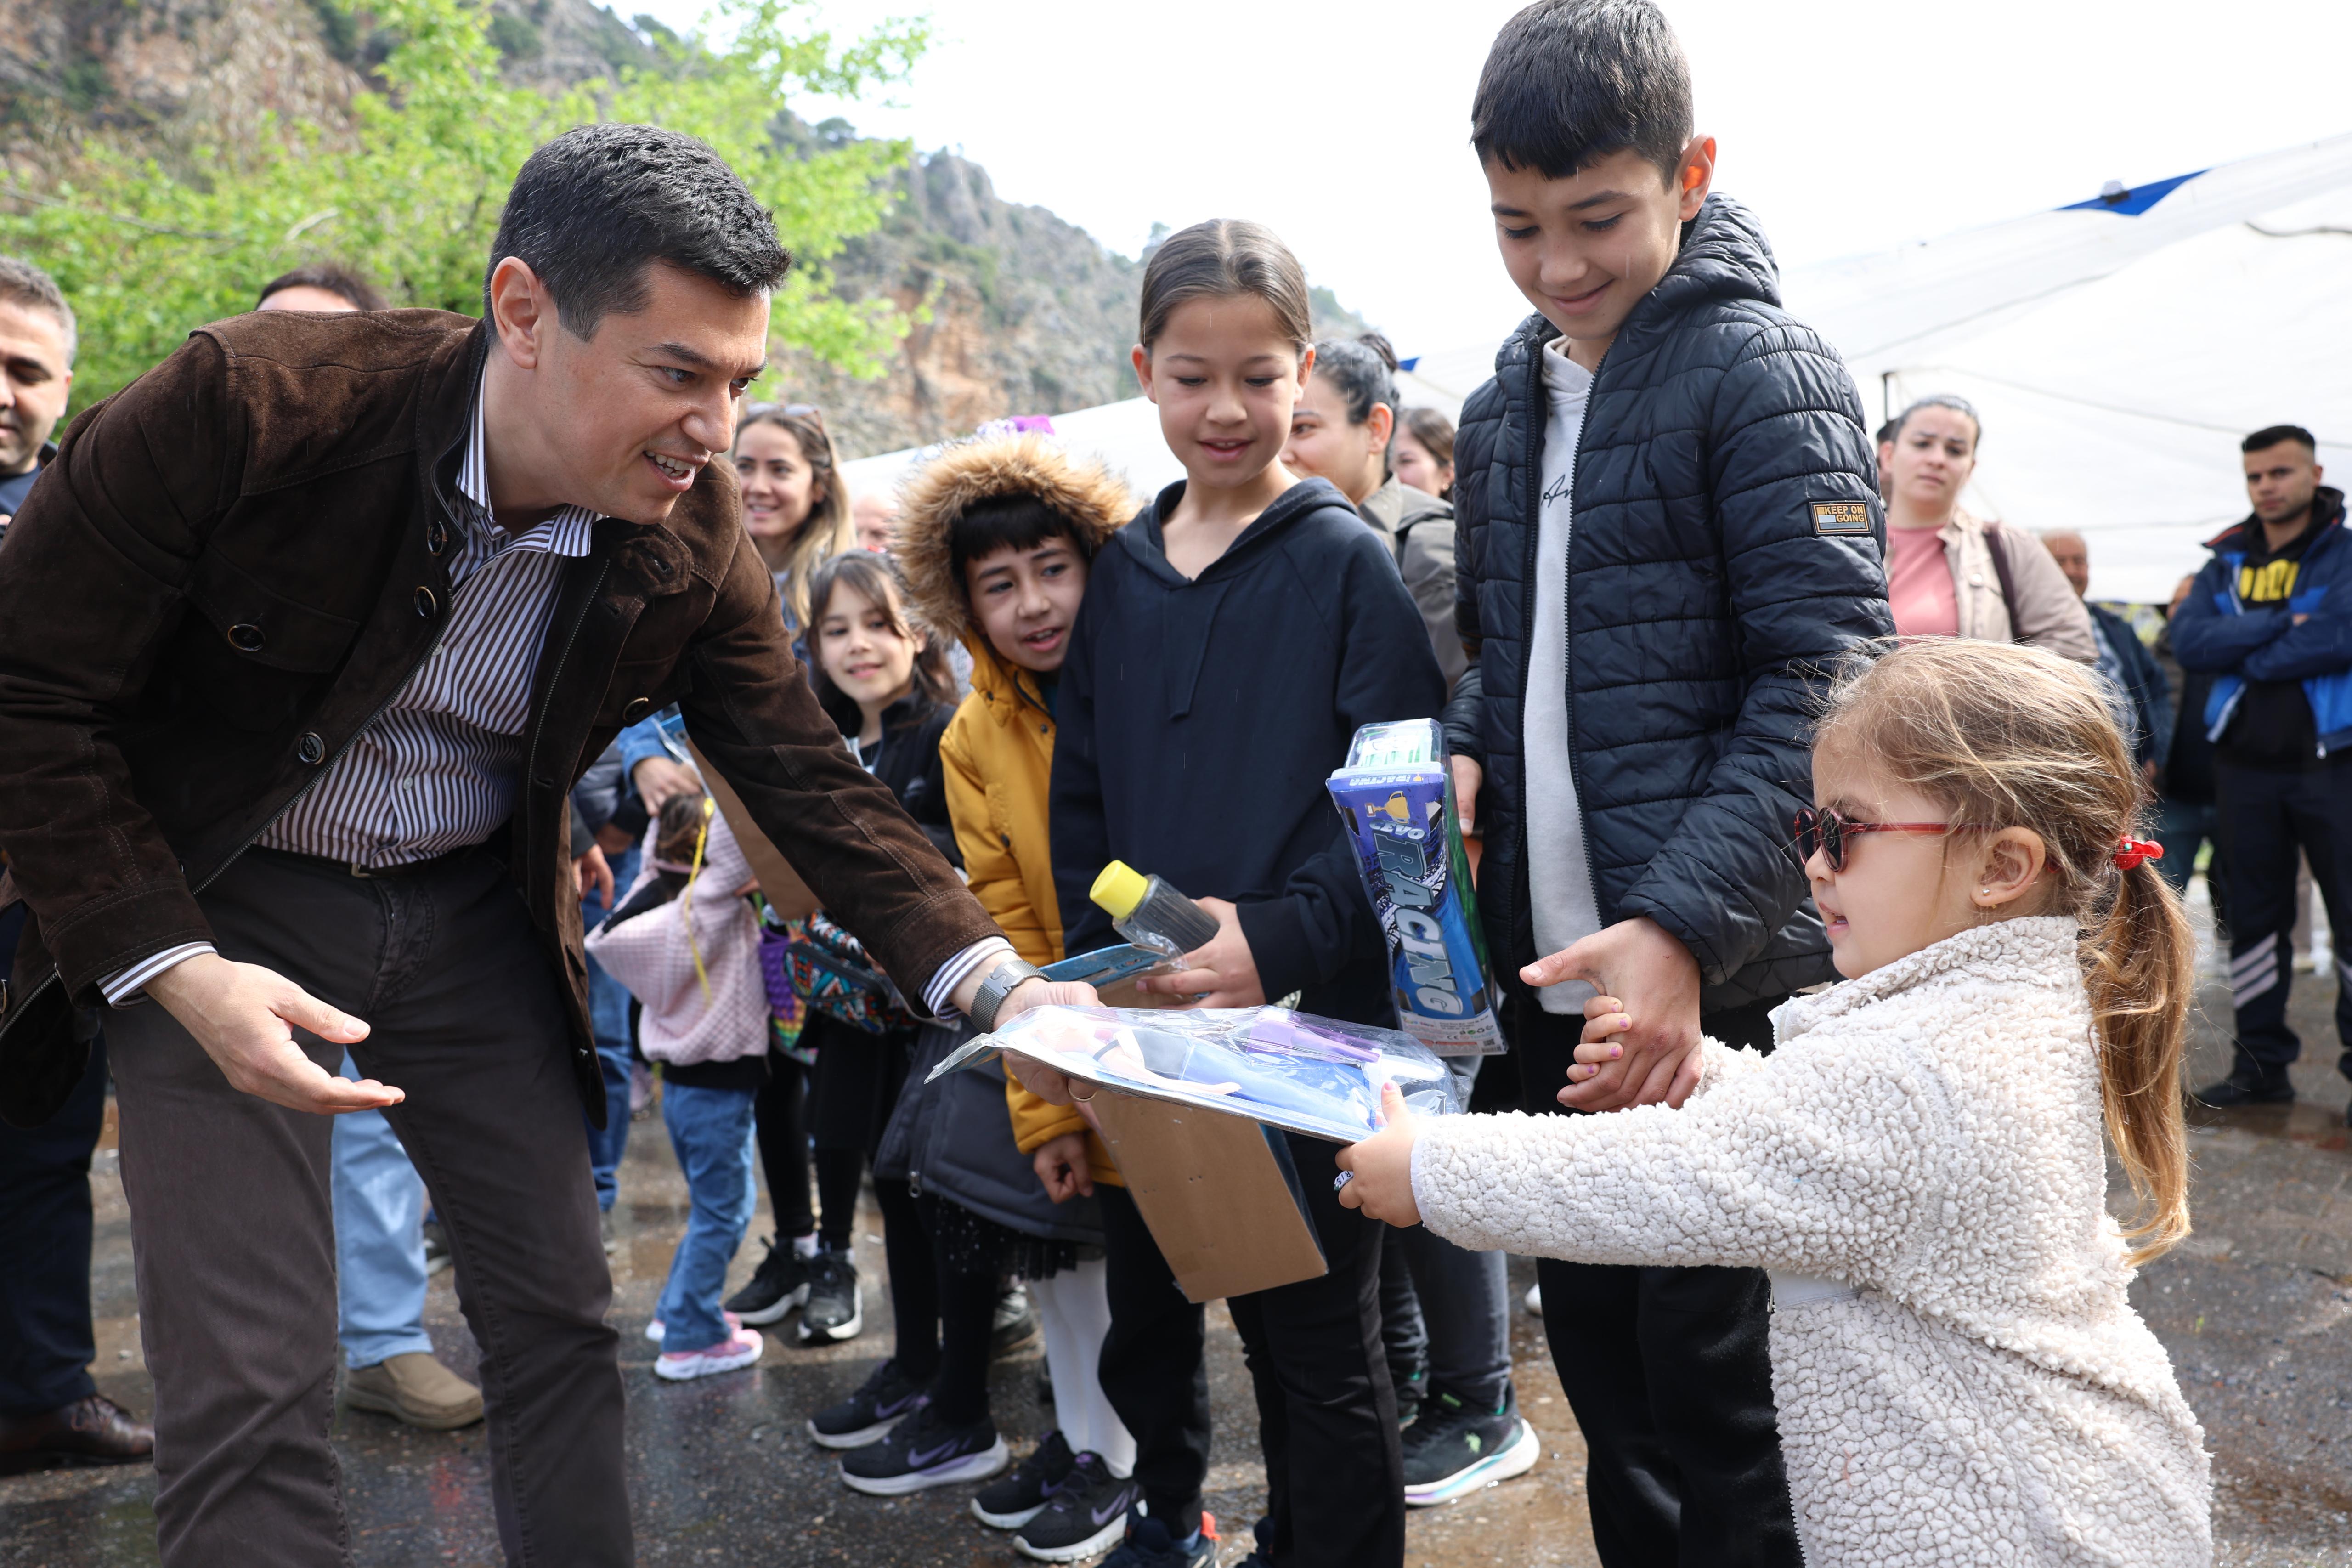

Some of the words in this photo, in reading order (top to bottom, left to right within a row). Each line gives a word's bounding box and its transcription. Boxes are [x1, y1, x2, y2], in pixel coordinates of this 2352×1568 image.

[1824, 506, 1848, 515] KEEP
[1836, 514, 1864, 522] GOING
[1349, 775, 1407, 786] RACING
[1369, 819, 1425, 840] CEVO
[1374, 833, 1464, 1015] RACING
